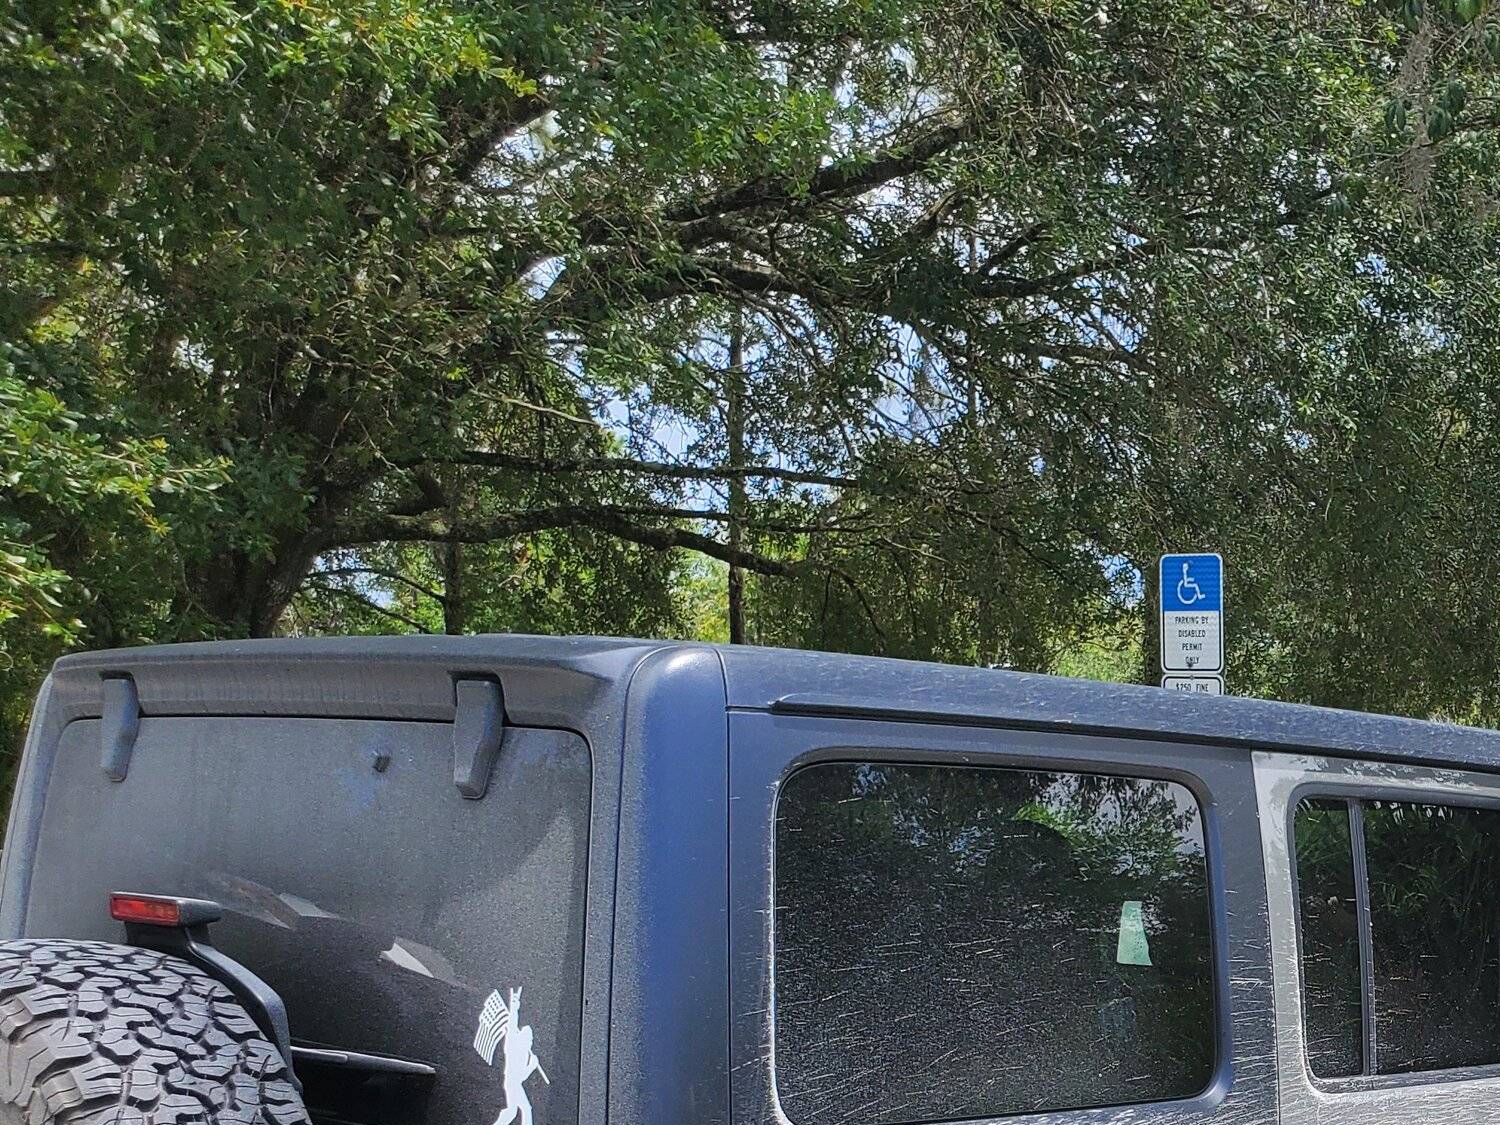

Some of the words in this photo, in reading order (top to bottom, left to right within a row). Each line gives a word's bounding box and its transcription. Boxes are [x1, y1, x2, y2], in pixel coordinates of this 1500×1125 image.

[1174, 616, 1199, 625] PARKING
[1201, 615, 1209, 624] BY
[1178, 629, 1206, 638] DISABLED
[1181, 643, 1203, 651] PERMIT
[1185, 656, 1200, 665] ONLY
[1196, 683, 1209, 692] FINE
